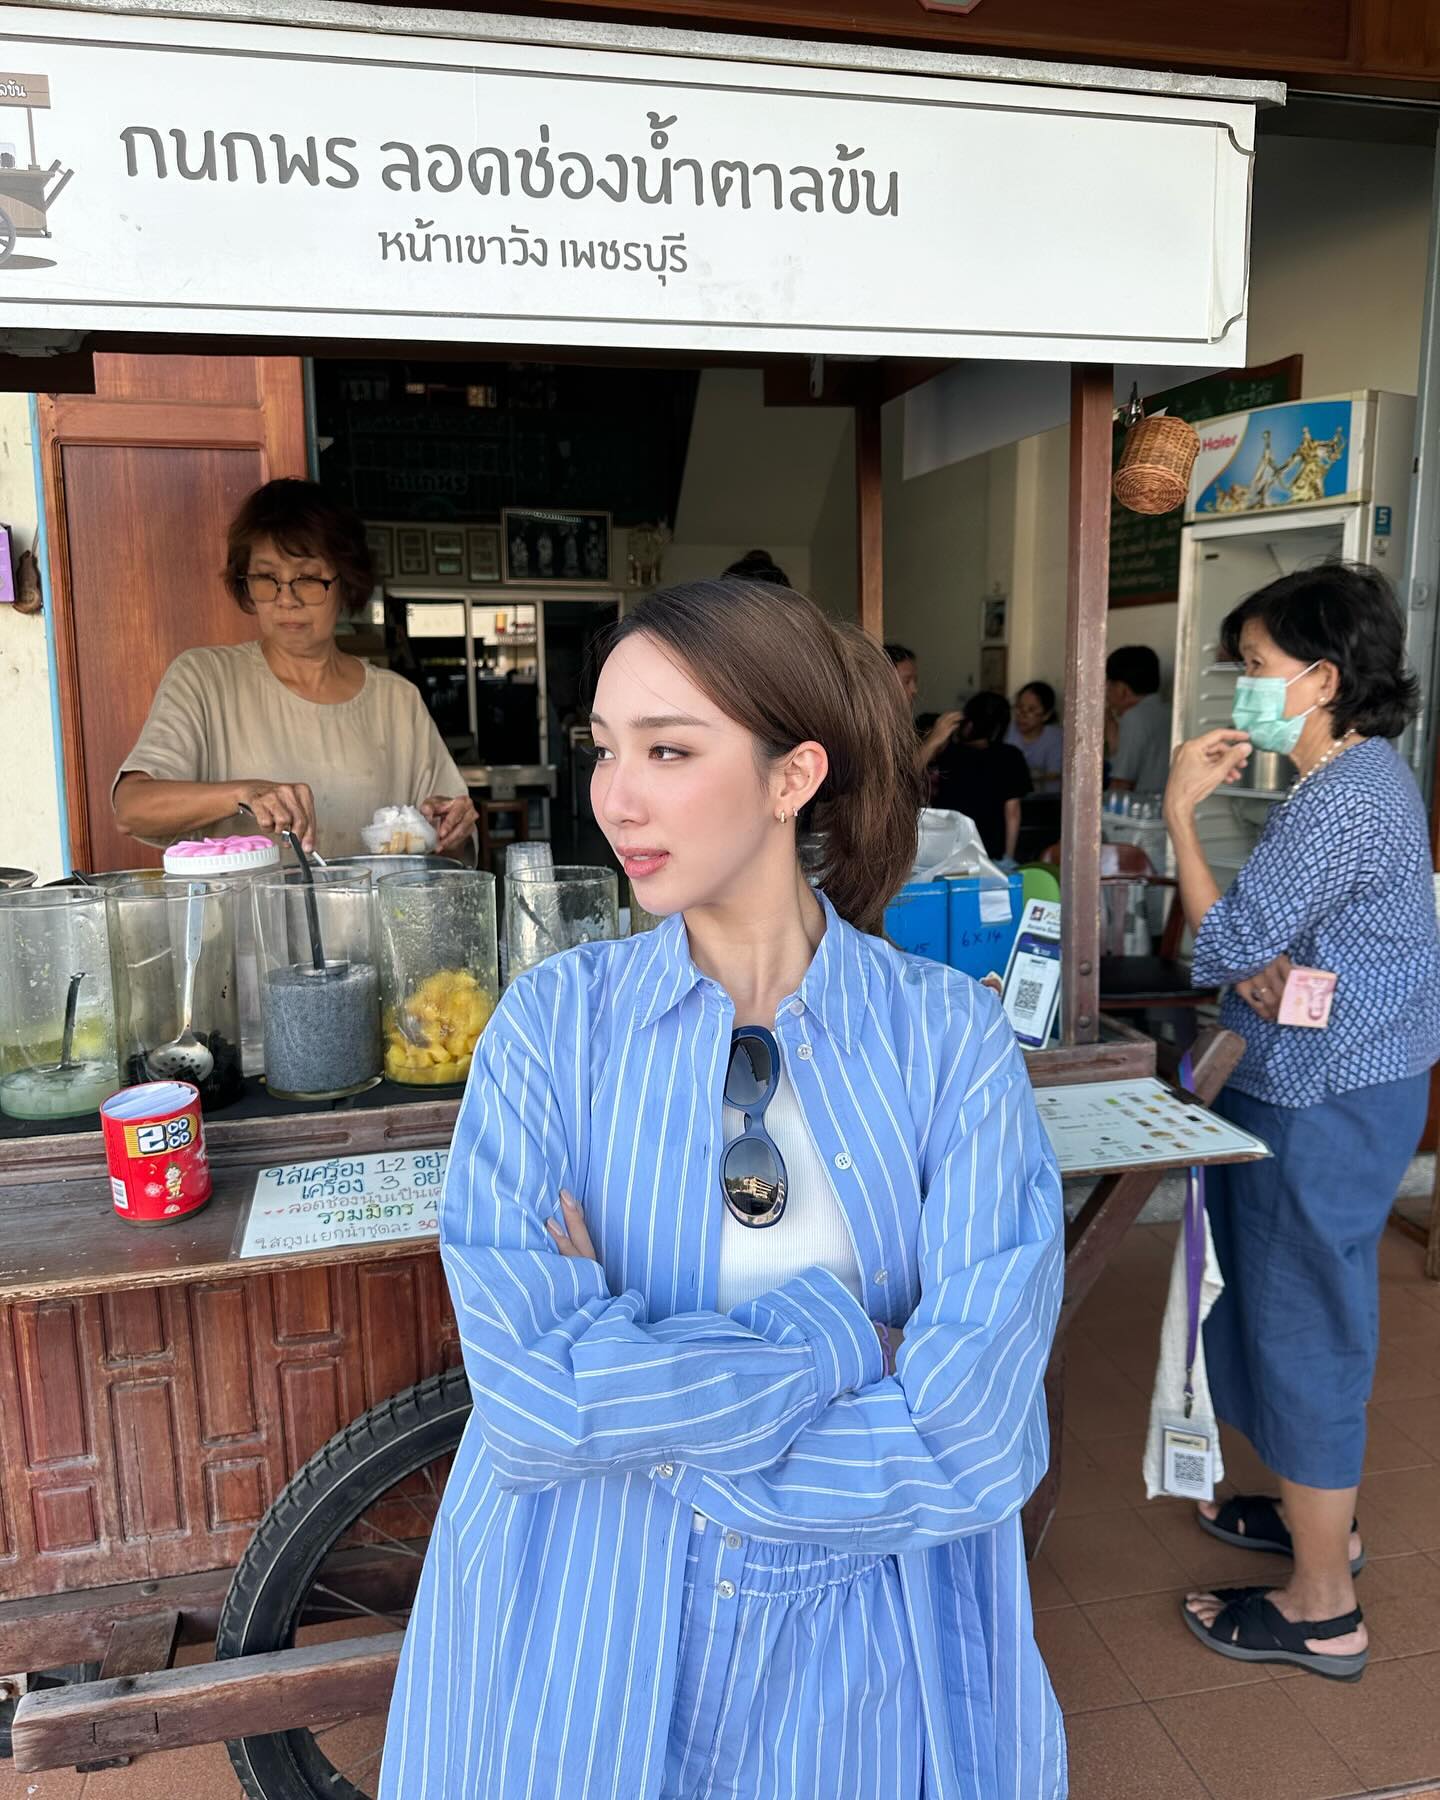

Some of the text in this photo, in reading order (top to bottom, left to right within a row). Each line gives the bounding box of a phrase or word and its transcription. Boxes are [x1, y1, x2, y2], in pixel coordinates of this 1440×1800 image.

[119, 111, 898, 217] กนกพร ลอดช่องน้ำตาลข้น
[378, 217, 689, 287] หน้าเขาวัง เพชรบุรี
[1202, 434, 1239, 451] Haier
[265, 1151, 449, 1186] ใส่เครื่อง 1-2 อย่า
[380, 1175, 400, 1190] 3
[317, 1200, 438, 1225] รวมมิตร 4
